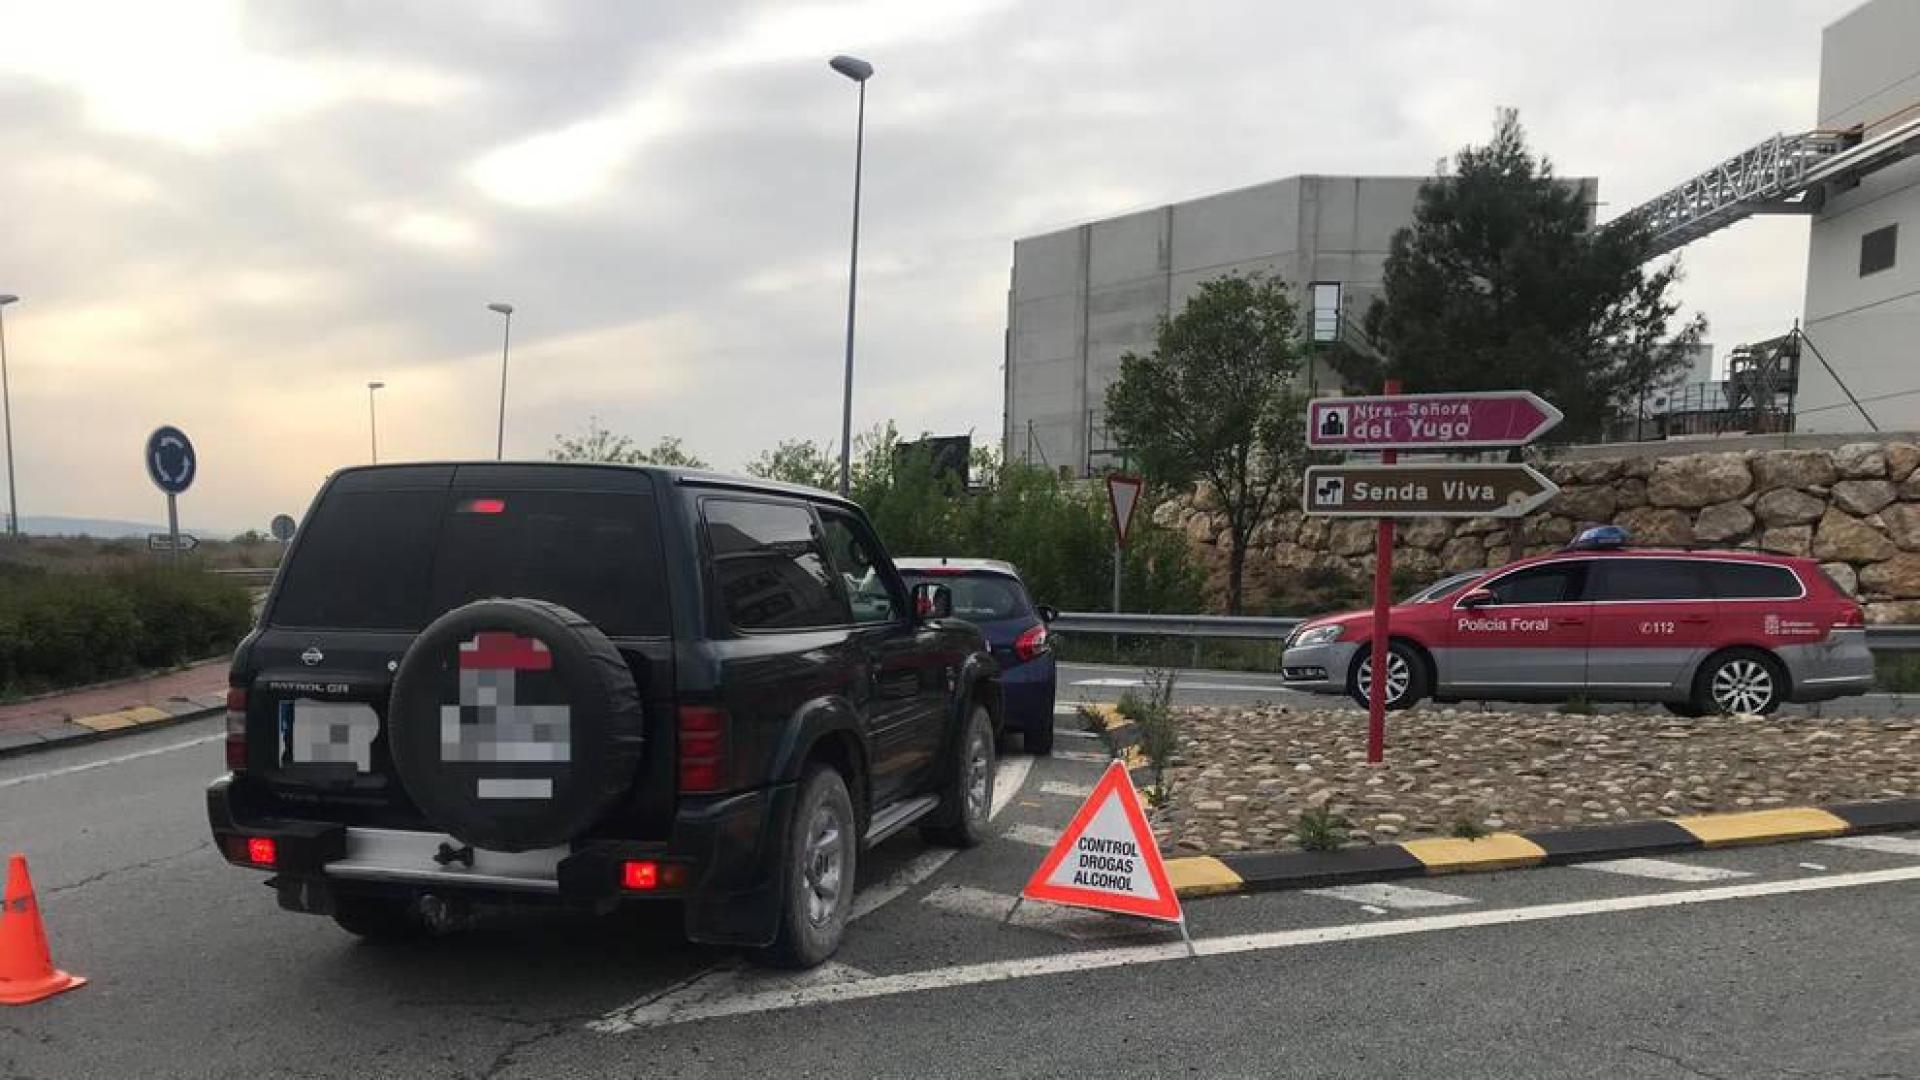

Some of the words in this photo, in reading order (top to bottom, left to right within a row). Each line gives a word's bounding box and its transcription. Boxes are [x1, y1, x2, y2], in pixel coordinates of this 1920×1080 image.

[1353, 420, 1392, 438] del
[1409, 419, 1469, 440] Yugo
[1352, 482, 1428, 500] Senda
[1442, 480, 1495, 500] Viva
[1511, 617, 1549, 631] Foral
[1078, 837, 1138, 857] CONTROL
[1079, 854, 1133, 874] DROGAS
[1073, 870, 1133, 892] ALCOHOL
